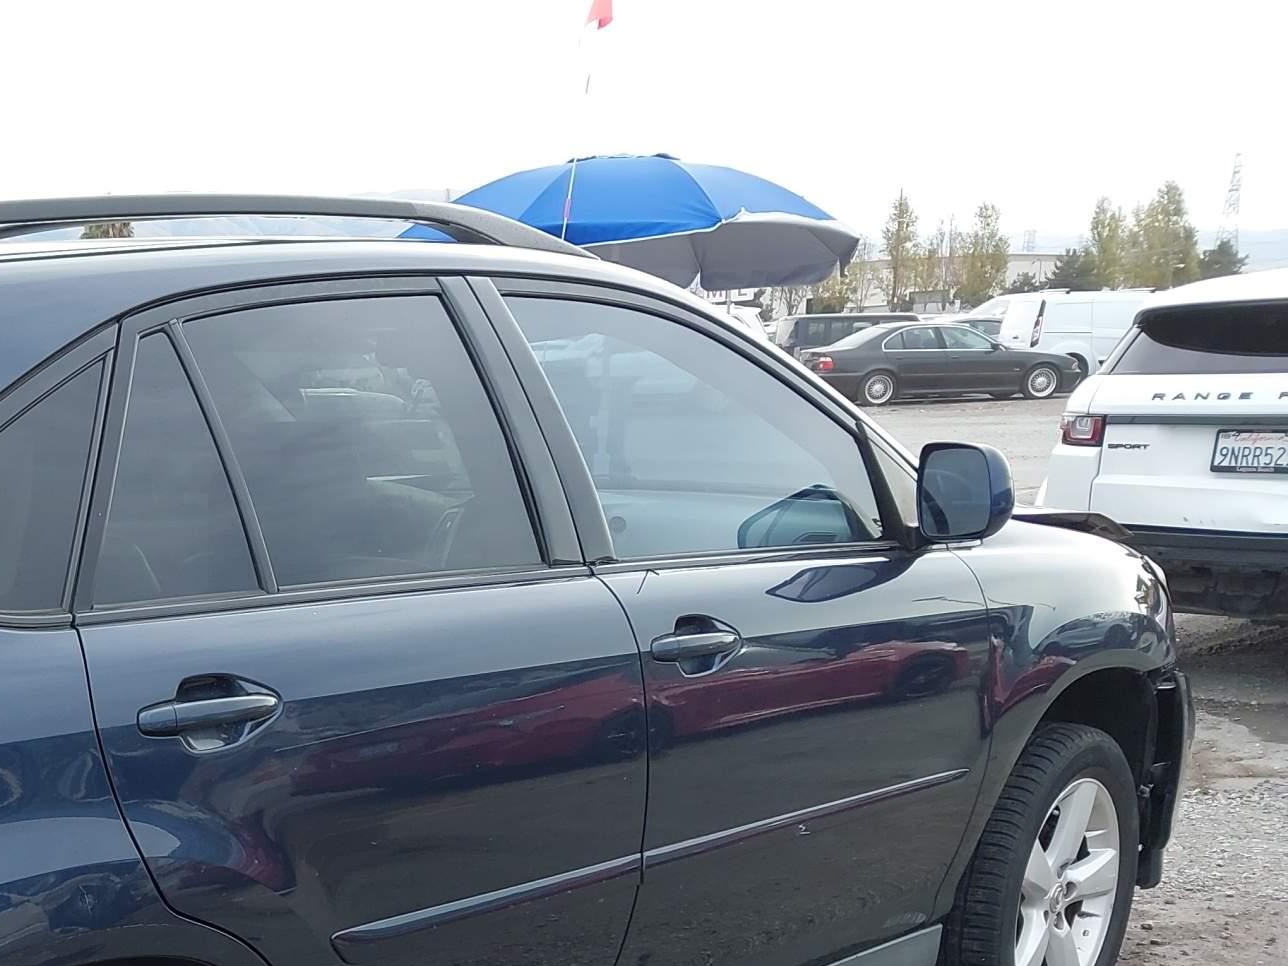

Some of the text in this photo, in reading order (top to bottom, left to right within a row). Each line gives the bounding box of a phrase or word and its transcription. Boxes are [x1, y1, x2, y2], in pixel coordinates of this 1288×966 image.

[1151, 391, 1254, 401] RANGE
[1107, 443, 1151, 451] SPORT
[1217, 446, 1288, 466] 9NRR52
